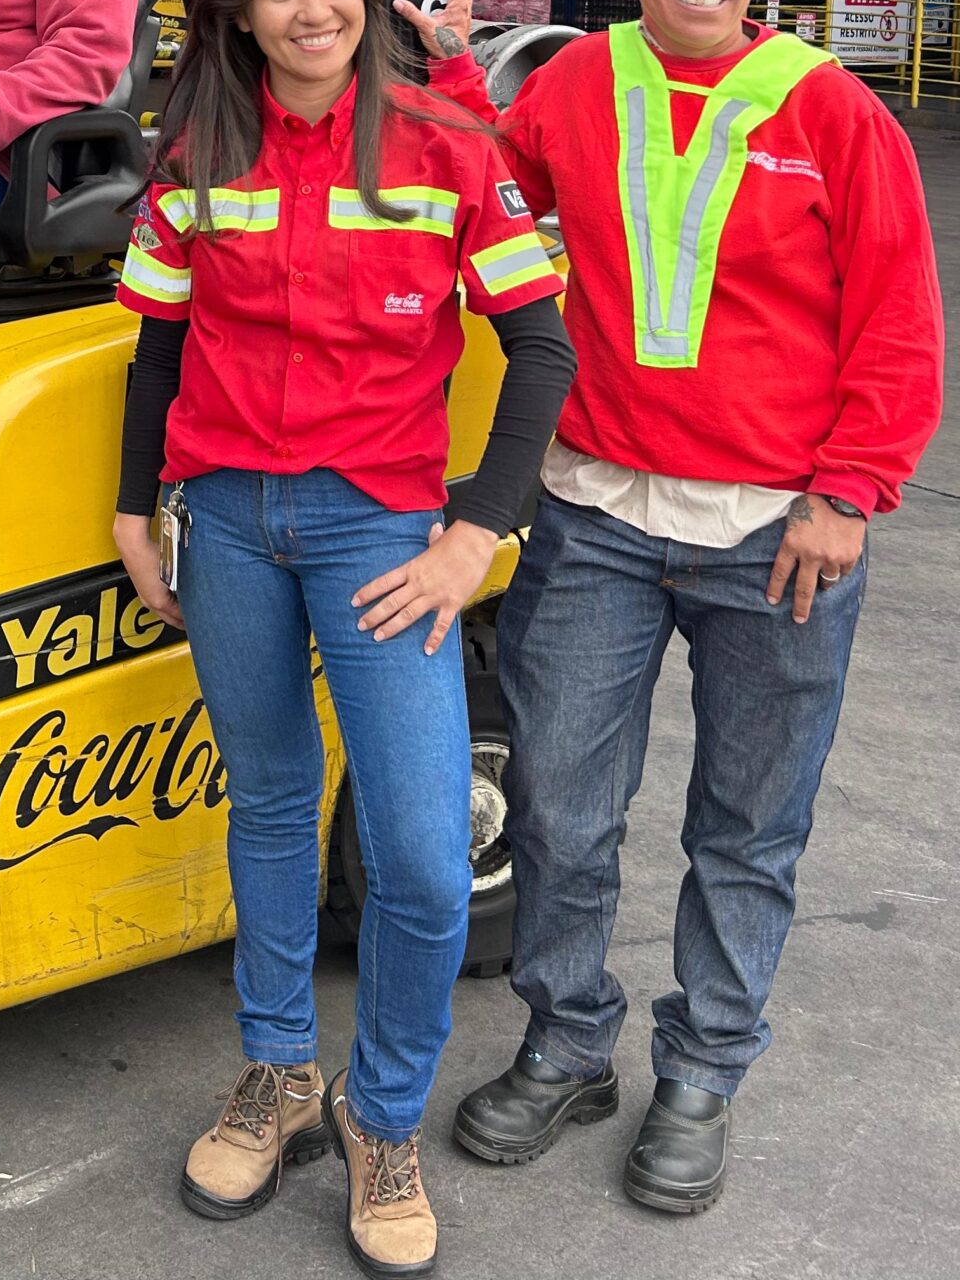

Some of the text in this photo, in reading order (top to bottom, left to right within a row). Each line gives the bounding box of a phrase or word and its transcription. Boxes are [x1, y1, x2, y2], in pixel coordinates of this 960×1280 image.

[160, 16, 179, 28] Yale
[844, 13, 874, 23] ACESSO
[840, 28, 877, 38] RESTRITO
[1, 587, 165, 689] Yale
